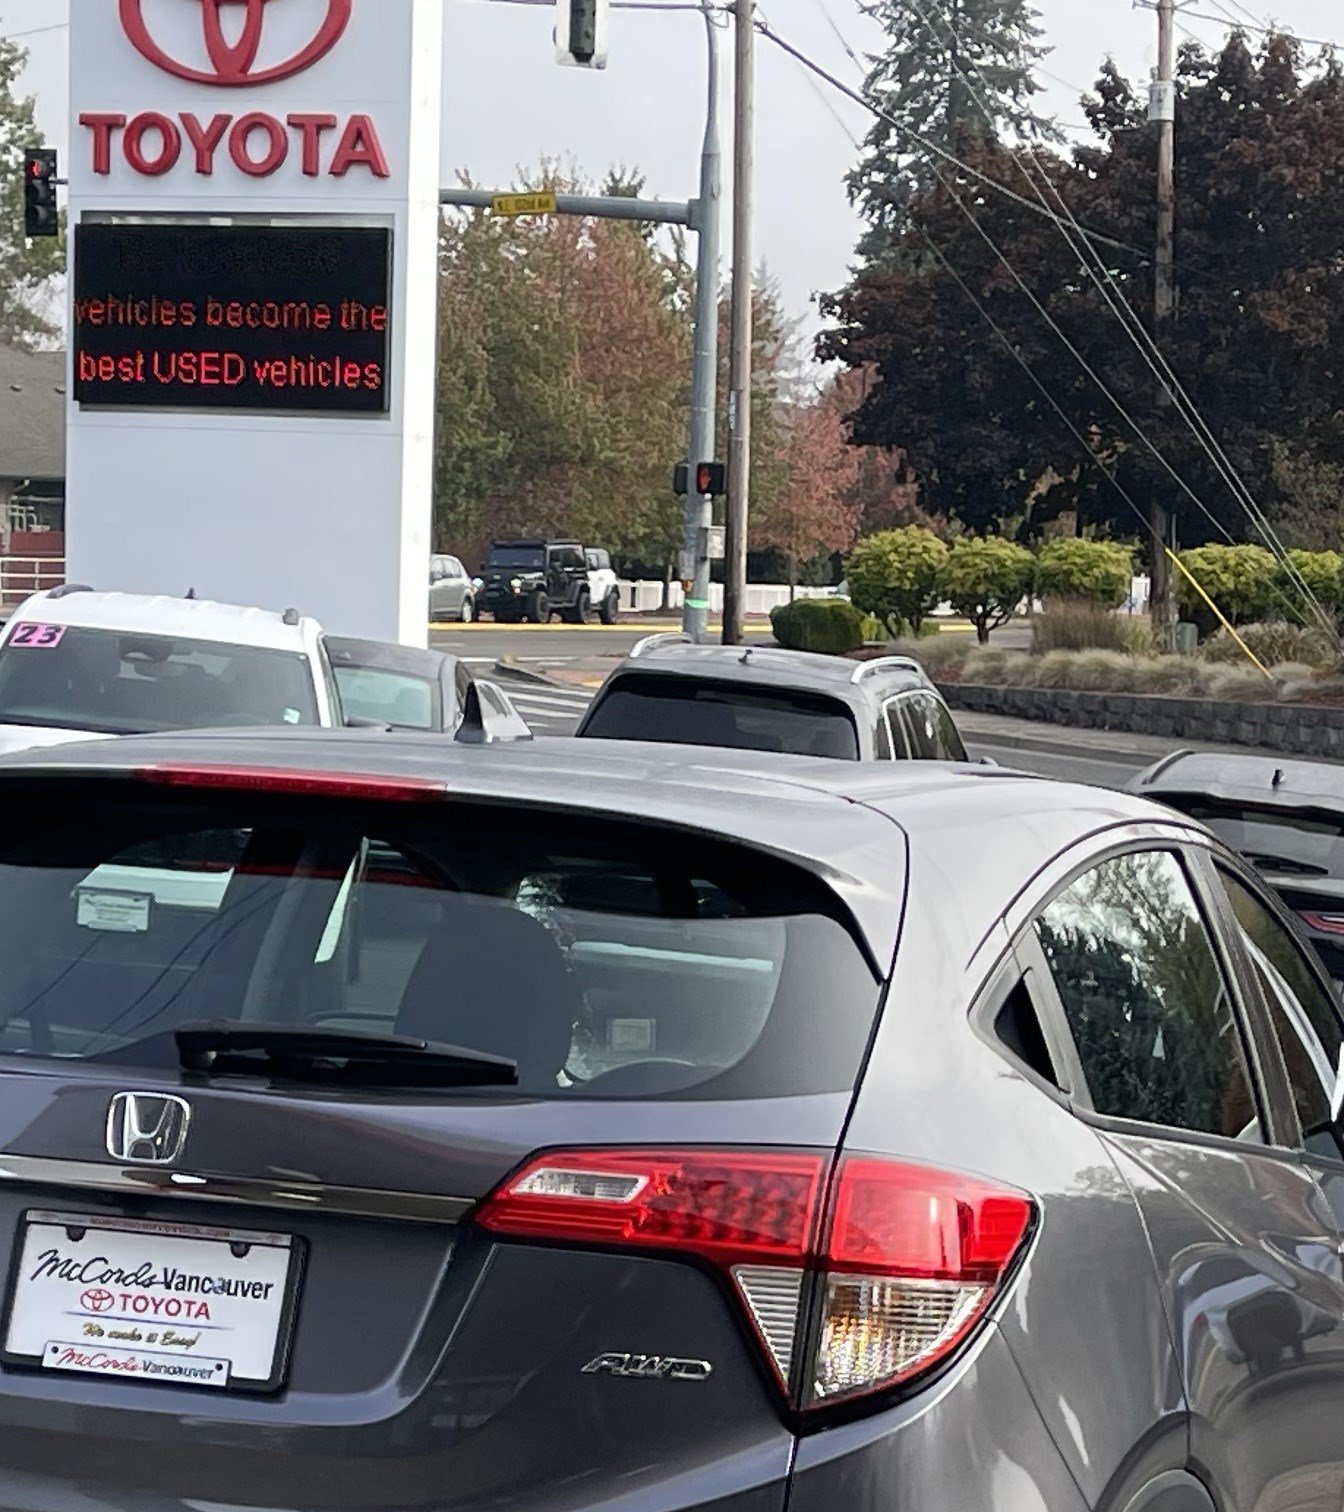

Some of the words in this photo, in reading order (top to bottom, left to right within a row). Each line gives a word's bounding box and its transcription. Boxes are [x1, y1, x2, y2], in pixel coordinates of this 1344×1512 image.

[79, 111, 390, 178] TOYOTA
[74, 293, 197, 327] vehicles
[206, 295, 332, 330] become
[341, 298, 388, 331] the
[79, 350, 145, 382] best
[153, 351, 246, 385] USED
[254, 354, 383, 390] vehicles
[14, 624, 62, 645] 23
[30, 1248, 160, 1289] McCords
[162, 1266, 274, 1300] Vancouver
[119, 1293, 212, 1320] TOYOTA
[142, 1359, 215, 1380] Vancouver
[580, 1352, 713, 1380] AWD
